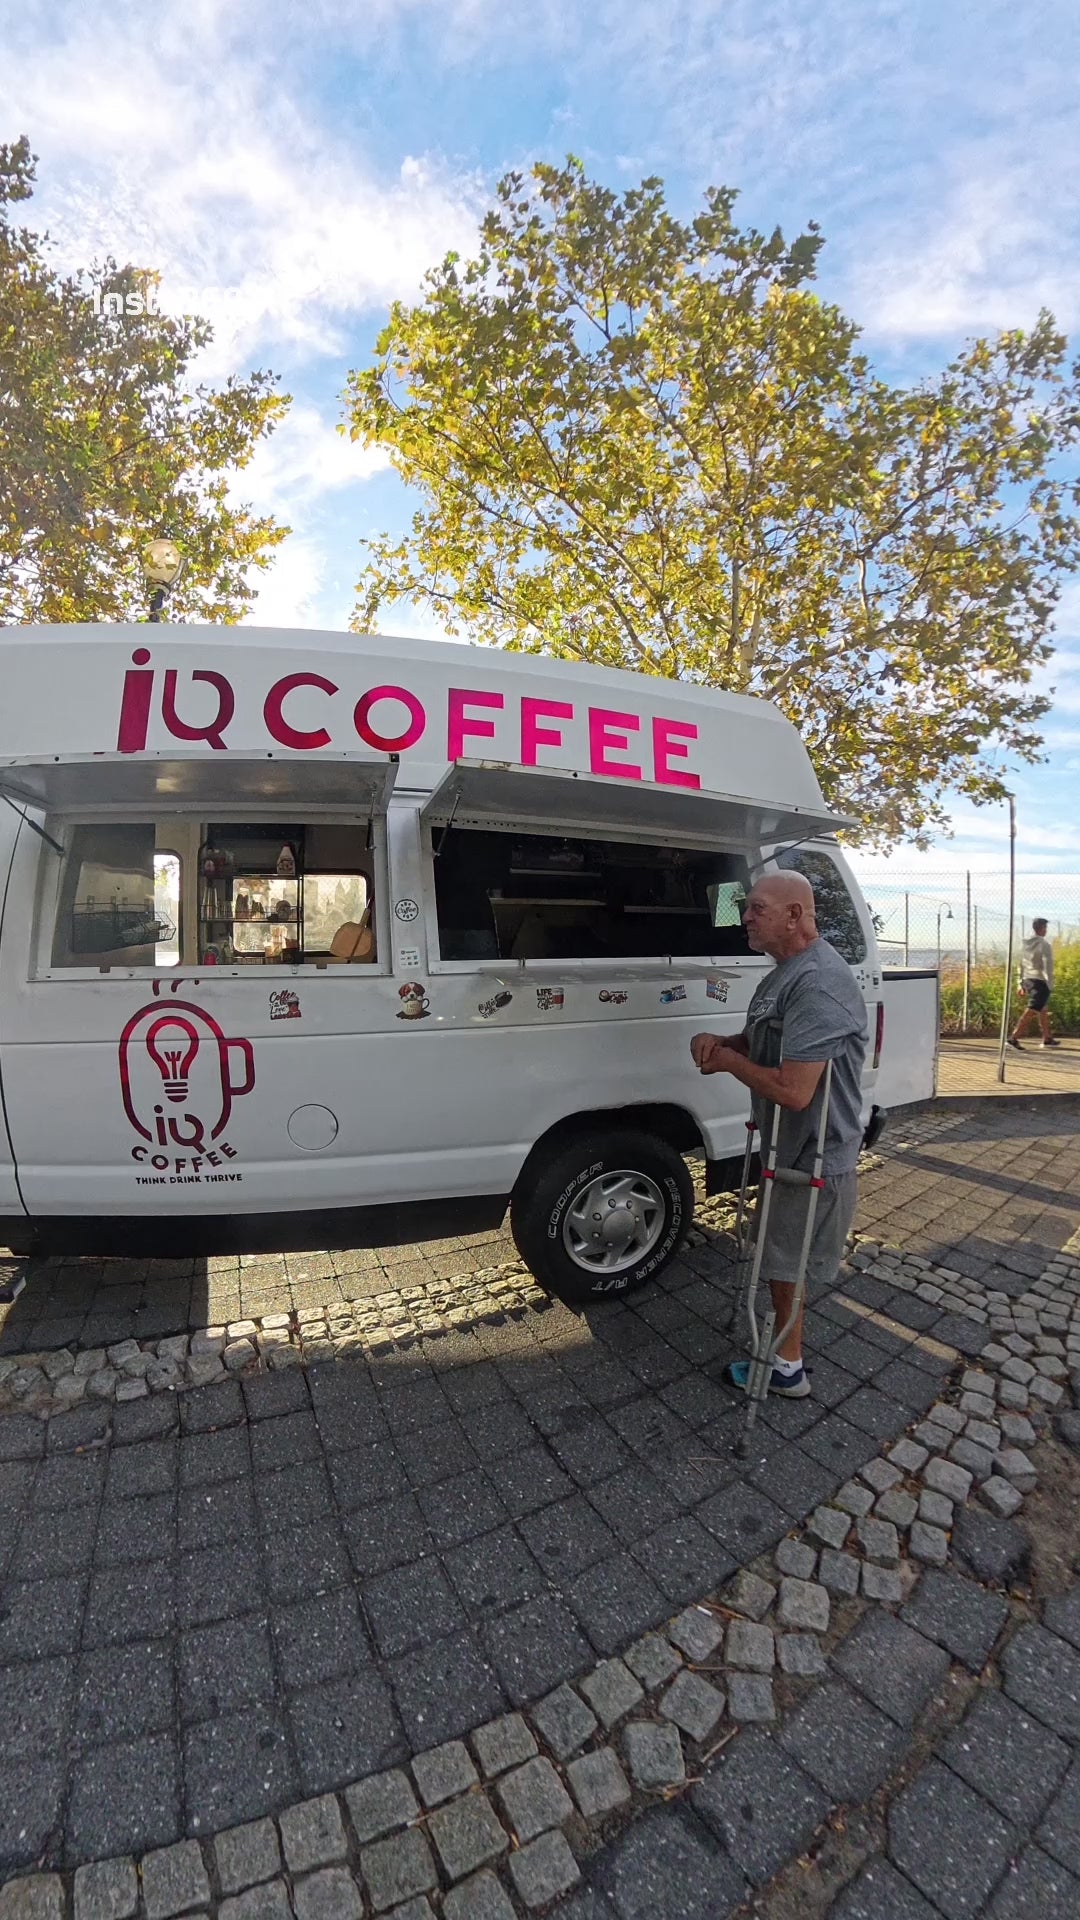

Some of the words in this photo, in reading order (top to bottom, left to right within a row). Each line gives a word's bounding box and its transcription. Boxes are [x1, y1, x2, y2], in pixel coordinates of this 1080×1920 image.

[263, 672, 701, 790] COFFEE
[131, 1142, 238, 1174] COFFEE
[136, 1176, 166, 1185] THINK
[169, 1175, 202, 1184] DRINK
[204, 1173, 243, 1183] THRIVE
[548, 1161, 604, 1239] COOPER
[635, 1177, 682, 1281] DISCOVERER
[591, 1277, 628, 1291] A/T
